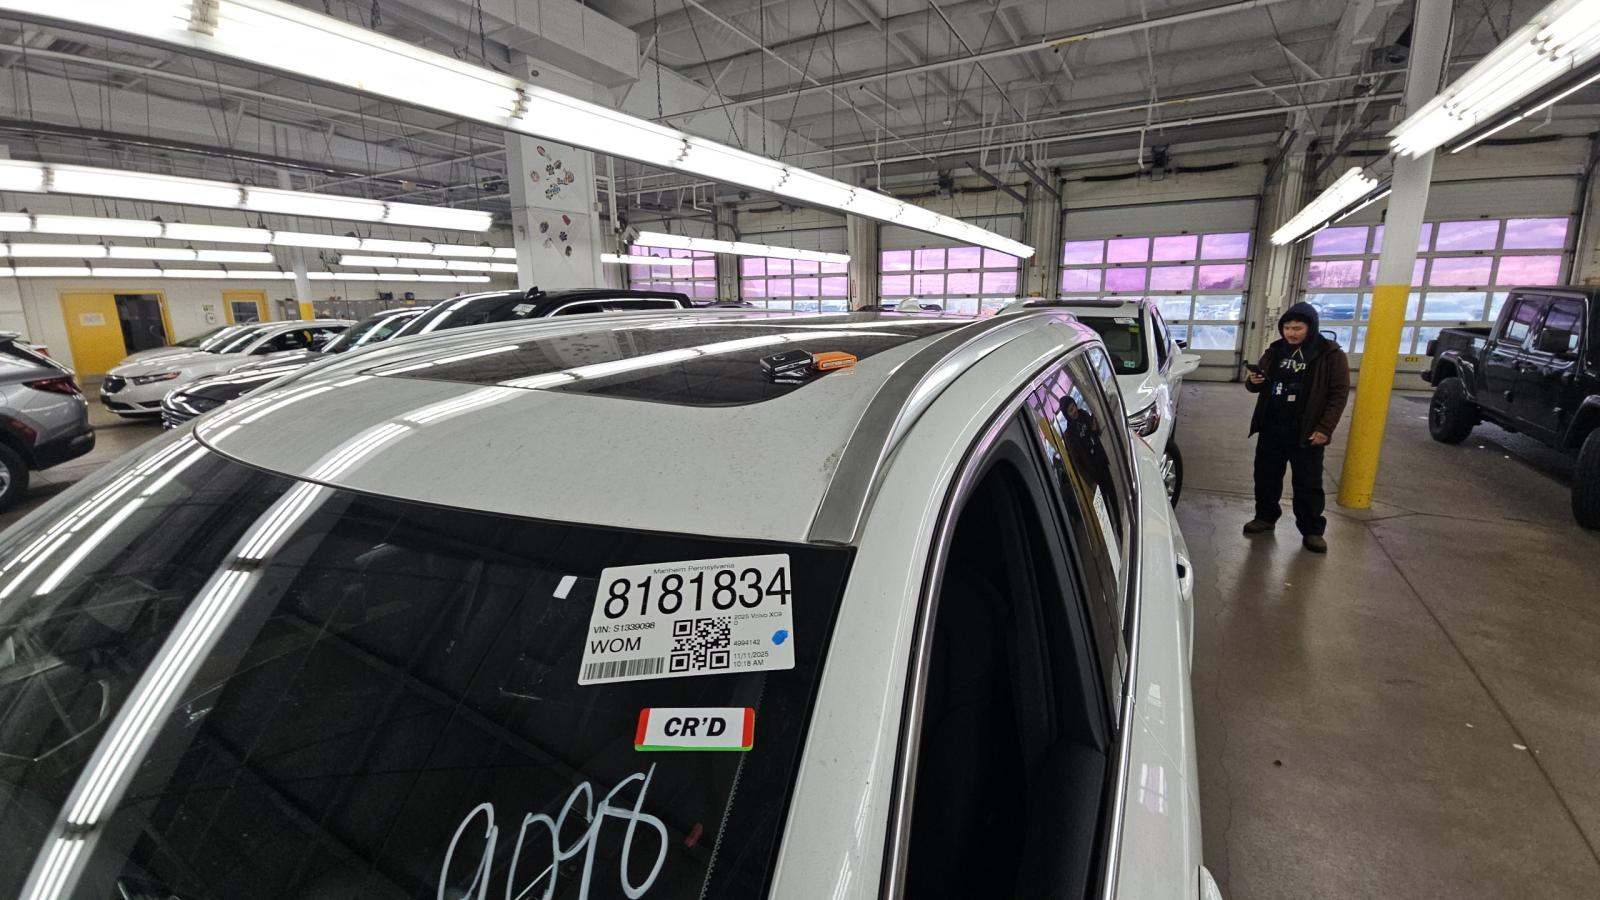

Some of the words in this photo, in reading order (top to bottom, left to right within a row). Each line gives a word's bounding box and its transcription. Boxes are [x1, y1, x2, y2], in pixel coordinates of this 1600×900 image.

[688, 563, 735, 572] Pennsylvania
[603, 567, 791, 619] 8181834
[593, 625, 611, 634] VIN:
[591, 636, 642, 655] WOM
[734, 650, 769, 659] 11/11/2025
[663, 717, 726, 738] CR'D
